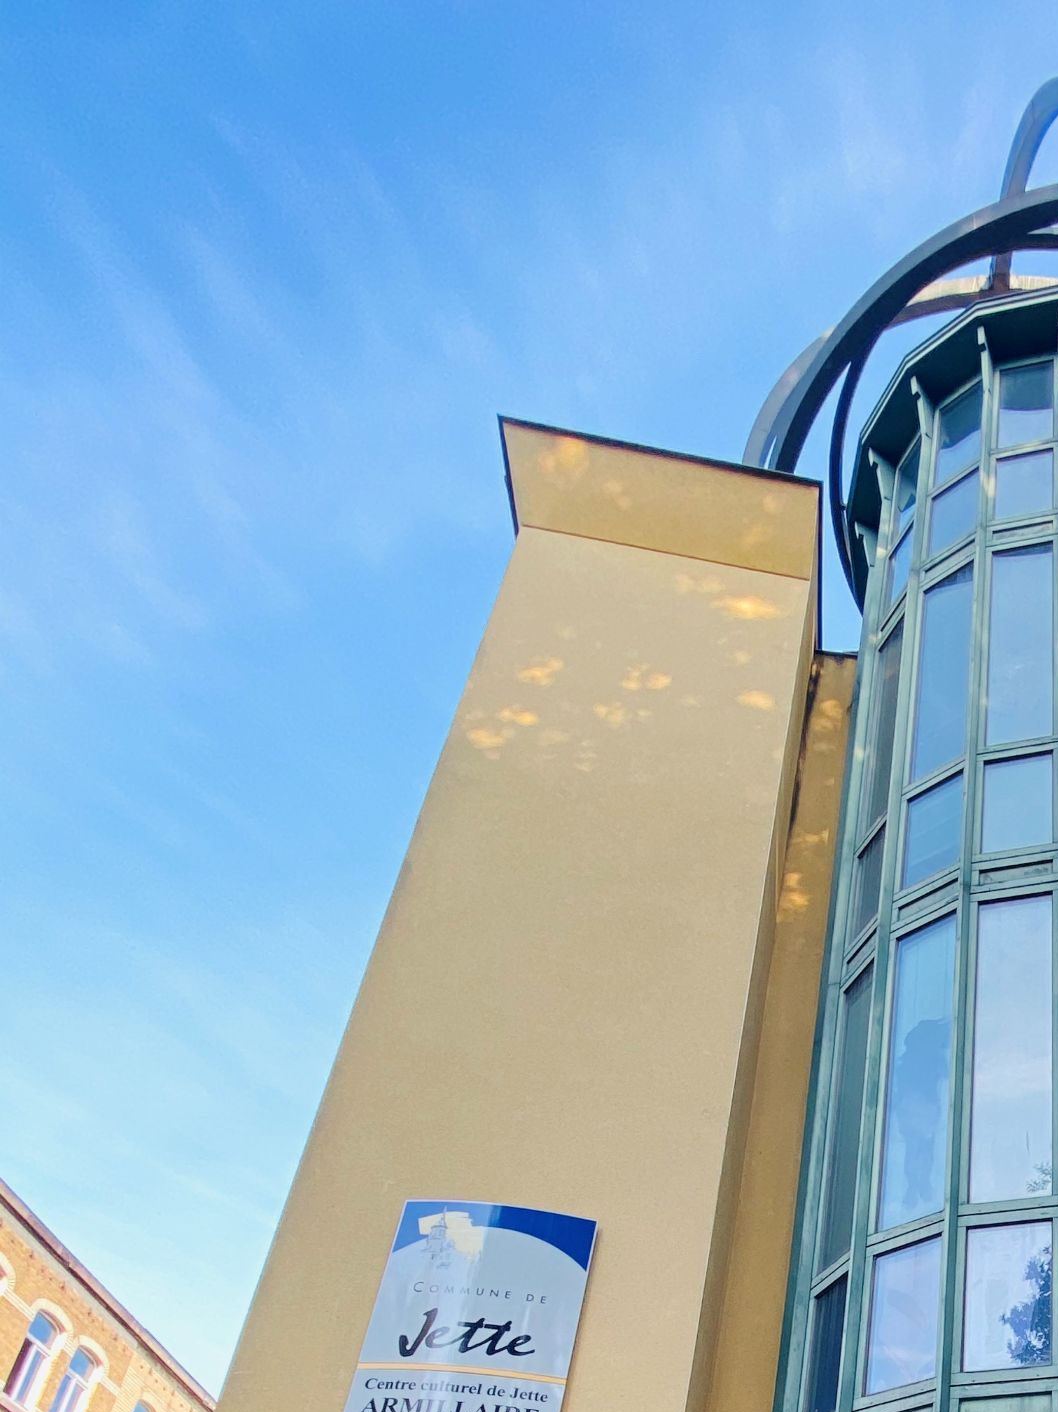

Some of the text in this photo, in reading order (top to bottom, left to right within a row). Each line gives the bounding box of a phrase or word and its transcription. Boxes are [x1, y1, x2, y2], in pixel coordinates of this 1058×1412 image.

[398, 1307, 535, 1358] Jette
[364, 1377, 549, 1403] Centre culturel de Jette
